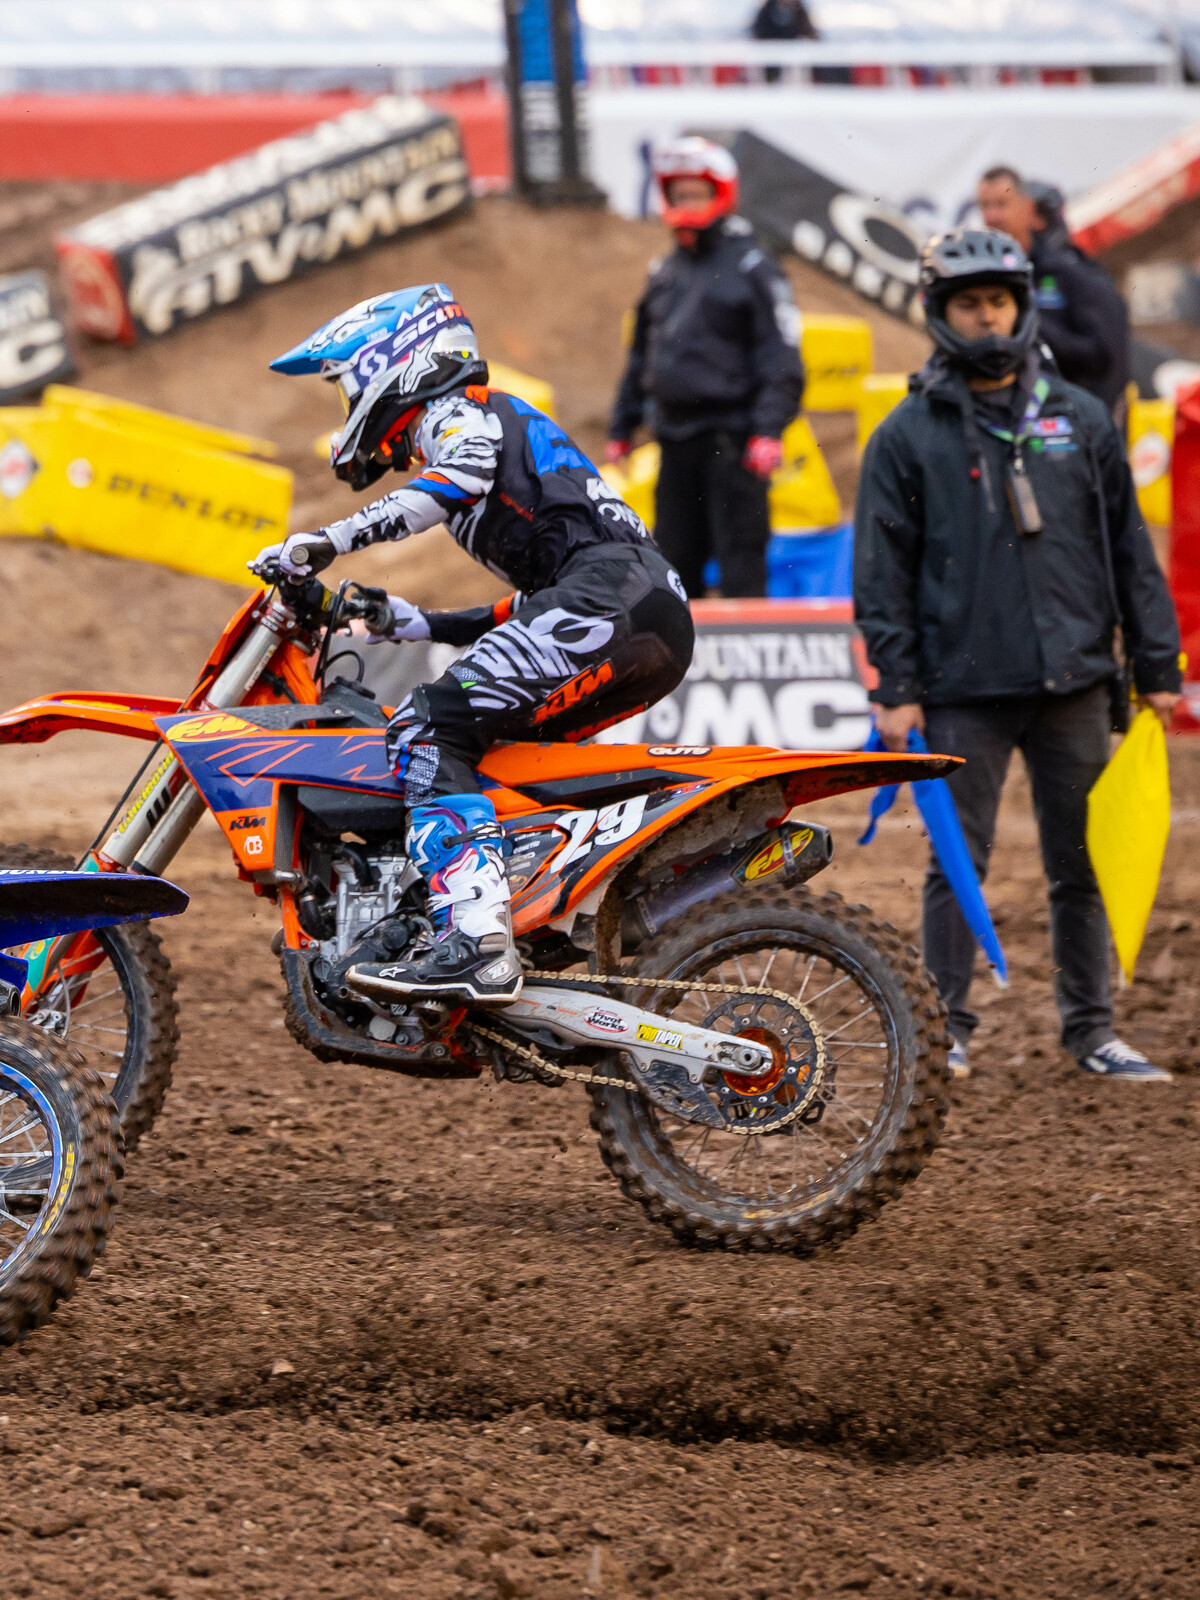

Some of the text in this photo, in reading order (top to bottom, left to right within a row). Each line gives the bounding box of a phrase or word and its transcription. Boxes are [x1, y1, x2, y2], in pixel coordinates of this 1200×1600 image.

[108, 472, 280, 532] DUNLOP
[533, 660, 614, 724] KTM
[649, 747, 711, 756] GUTS
[230, 814, 267, 831] KTM
[550, 794, 650, 875] 29
[588, 1016, 625, 1031] Works
[593, 1012, 623, 1024] Pivot
[638, 1025, 682, 1048] PROTAPER
